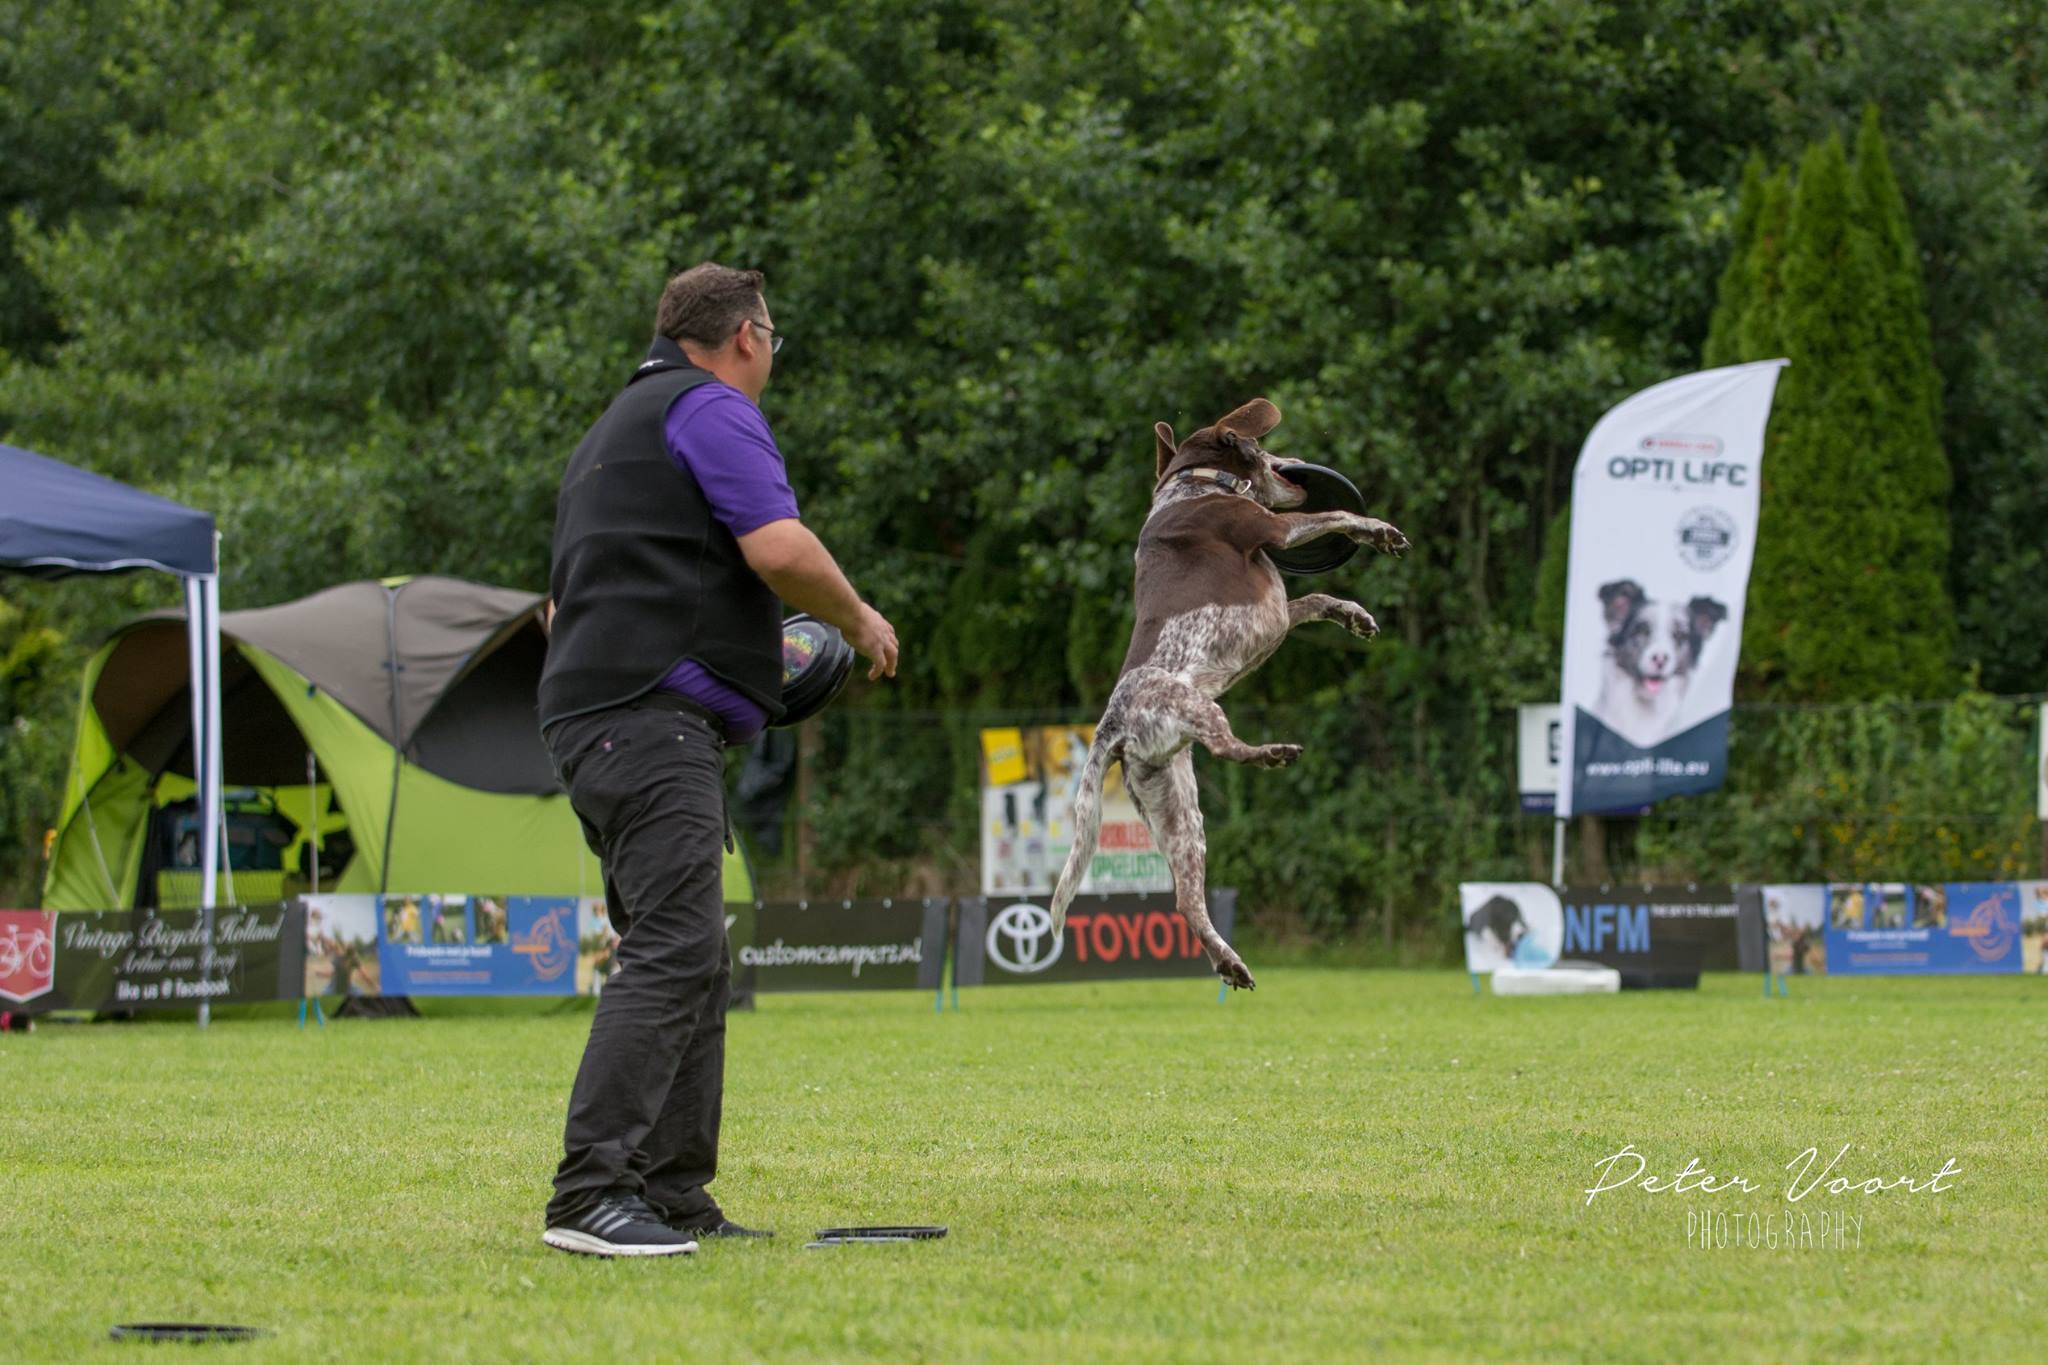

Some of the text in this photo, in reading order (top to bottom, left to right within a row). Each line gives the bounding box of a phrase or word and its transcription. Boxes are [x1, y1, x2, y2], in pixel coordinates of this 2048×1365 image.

[1608, 455, 1748, 487] OPTI LIFE
[64, 914, 285, 959] Vintage Bicycles Holland
[1565, 903, 1650, 953] NFM
[117, 980, 140, 1000] like
[142, 983, 159, 1000] us
[175, 977, 230, 998] facebook
